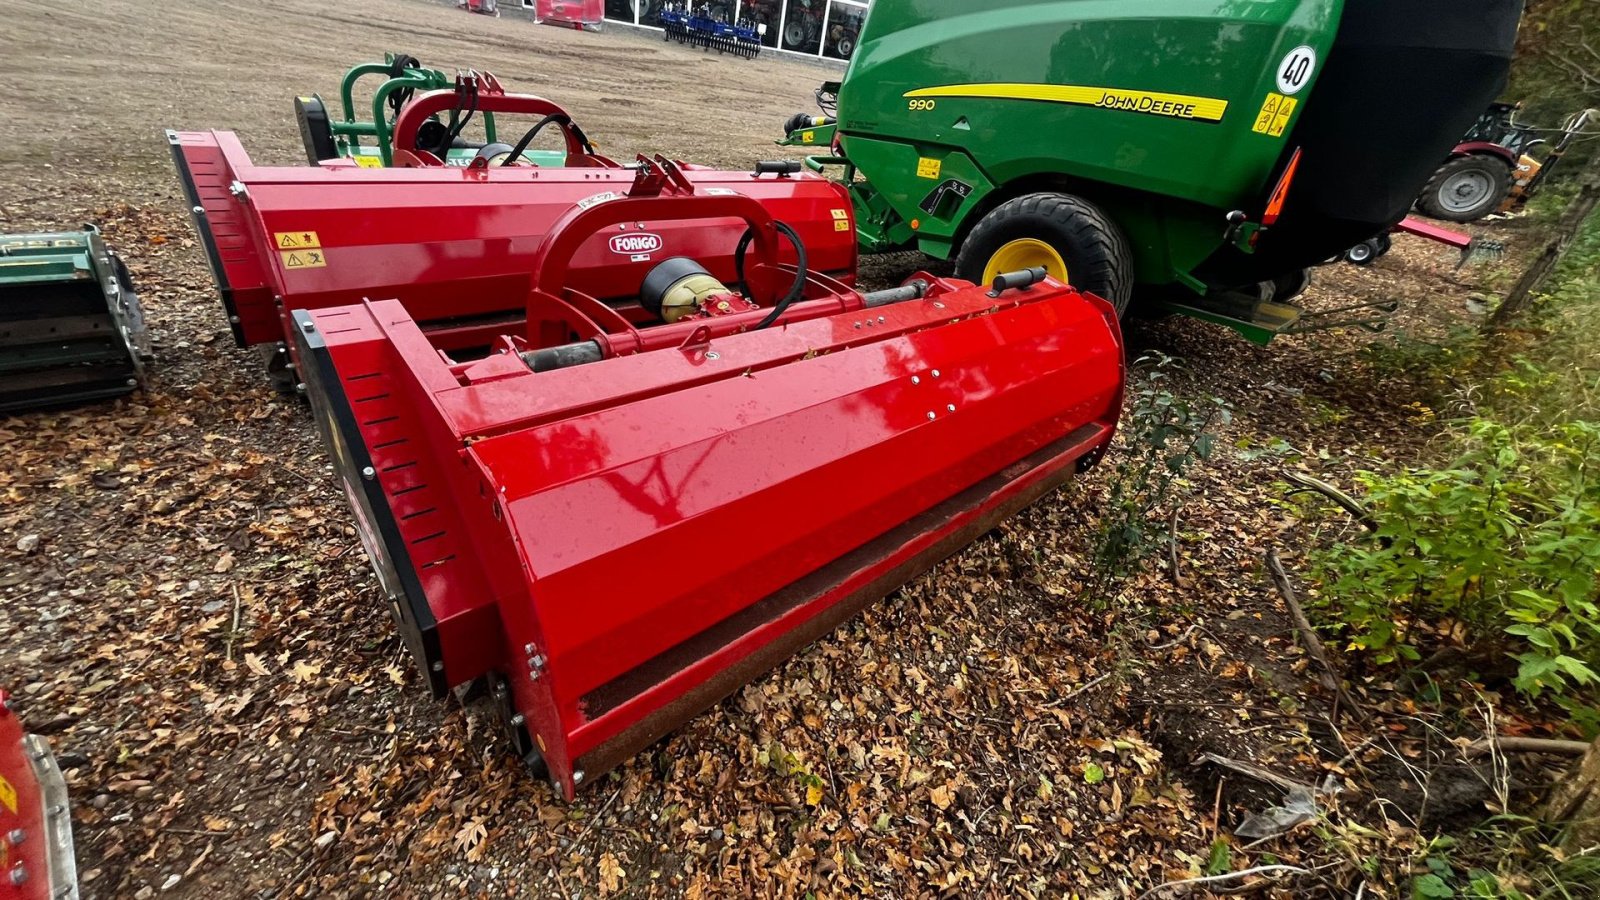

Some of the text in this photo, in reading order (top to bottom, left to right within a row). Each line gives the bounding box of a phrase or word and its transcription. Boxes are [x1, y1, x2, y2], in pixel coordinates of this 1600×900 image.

[1282, 54, 1310, 86] 40
[908, 99, 936, 111] 990
[1094, 92, 1196, 116] JOHN DEERE
[614, 236, 657, 252] FORIGO
